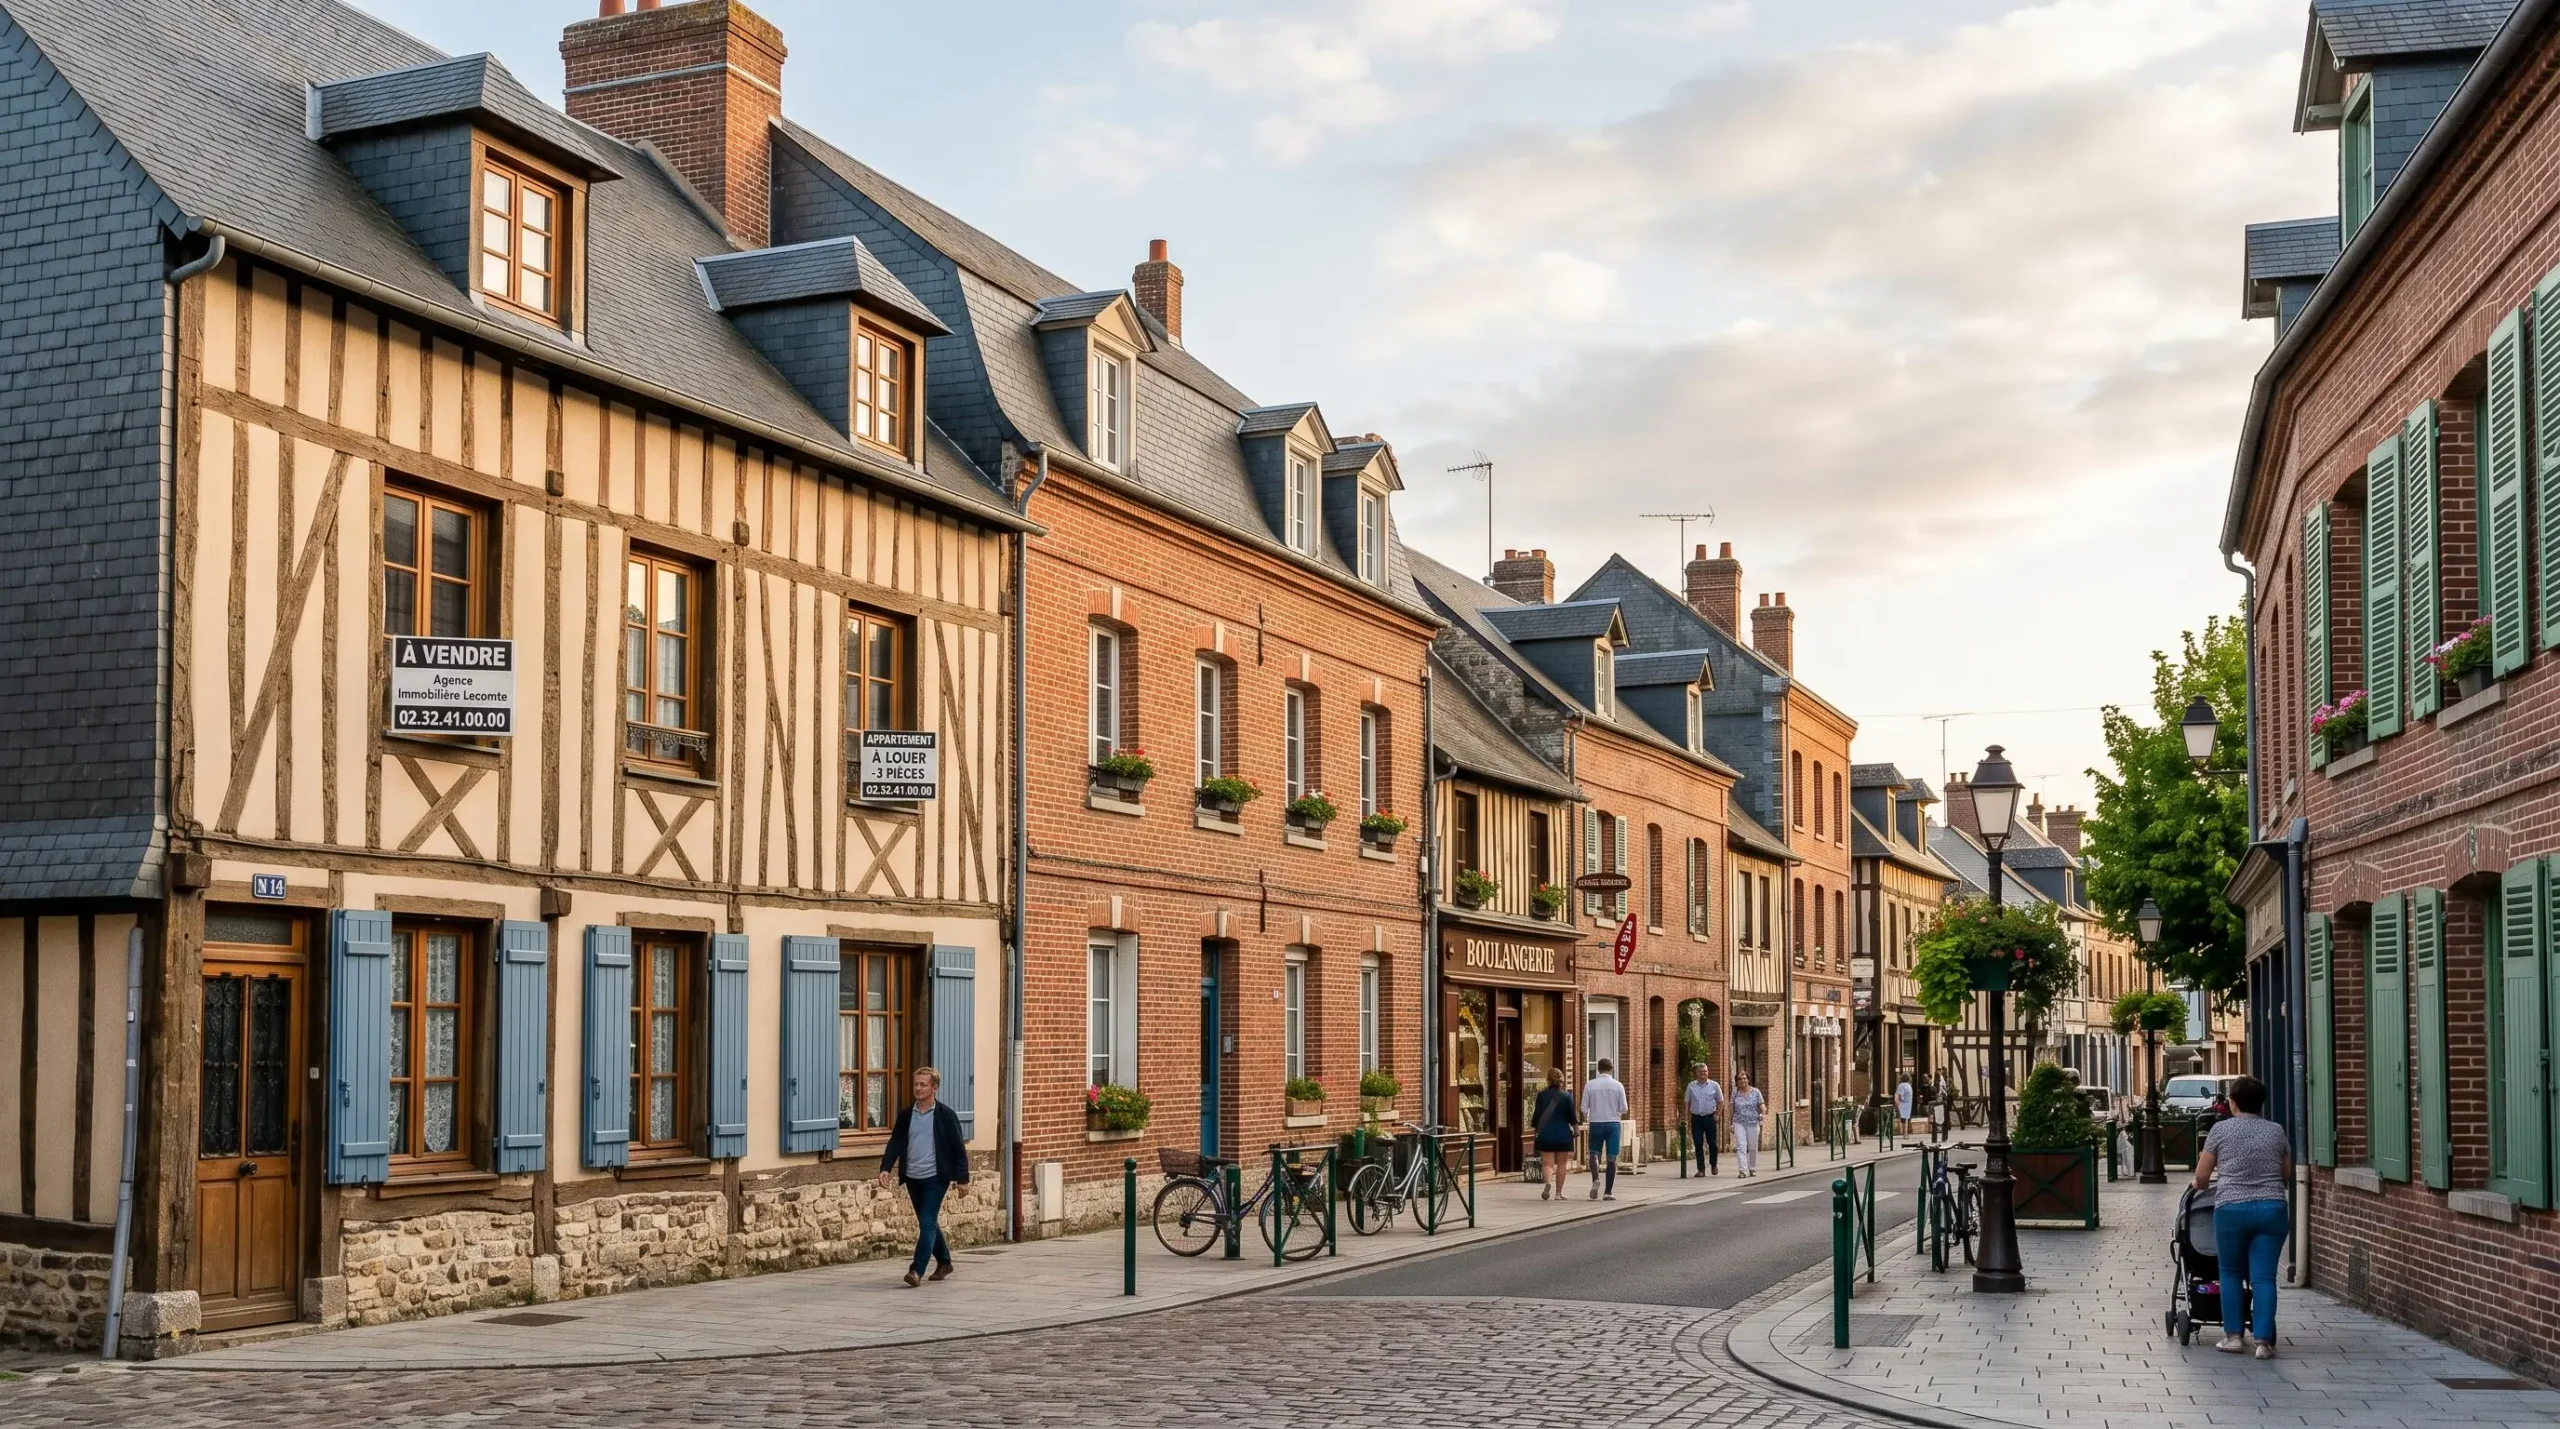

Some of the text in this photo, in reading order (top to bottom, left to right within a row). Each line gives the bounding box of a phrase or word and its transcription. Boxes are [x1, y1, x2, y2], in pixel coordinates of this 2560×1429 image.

[401, 640, 506, 667] À VENDRE
[433, 674, 473, 688] Agence
[398, 688, 508, 702] Immobilière Lecomte
[399, 709, 506, 728] 02.32.41.00.00
[867, 734, 932, 745] APPARTEMENT
[872, 749, 926, 764] À LOUER
[886, 766, 925, 779] PIÈCES
[258, 879, 284, 895] N 14
[1466, 939, 1555, 973] BOULANGERIE
